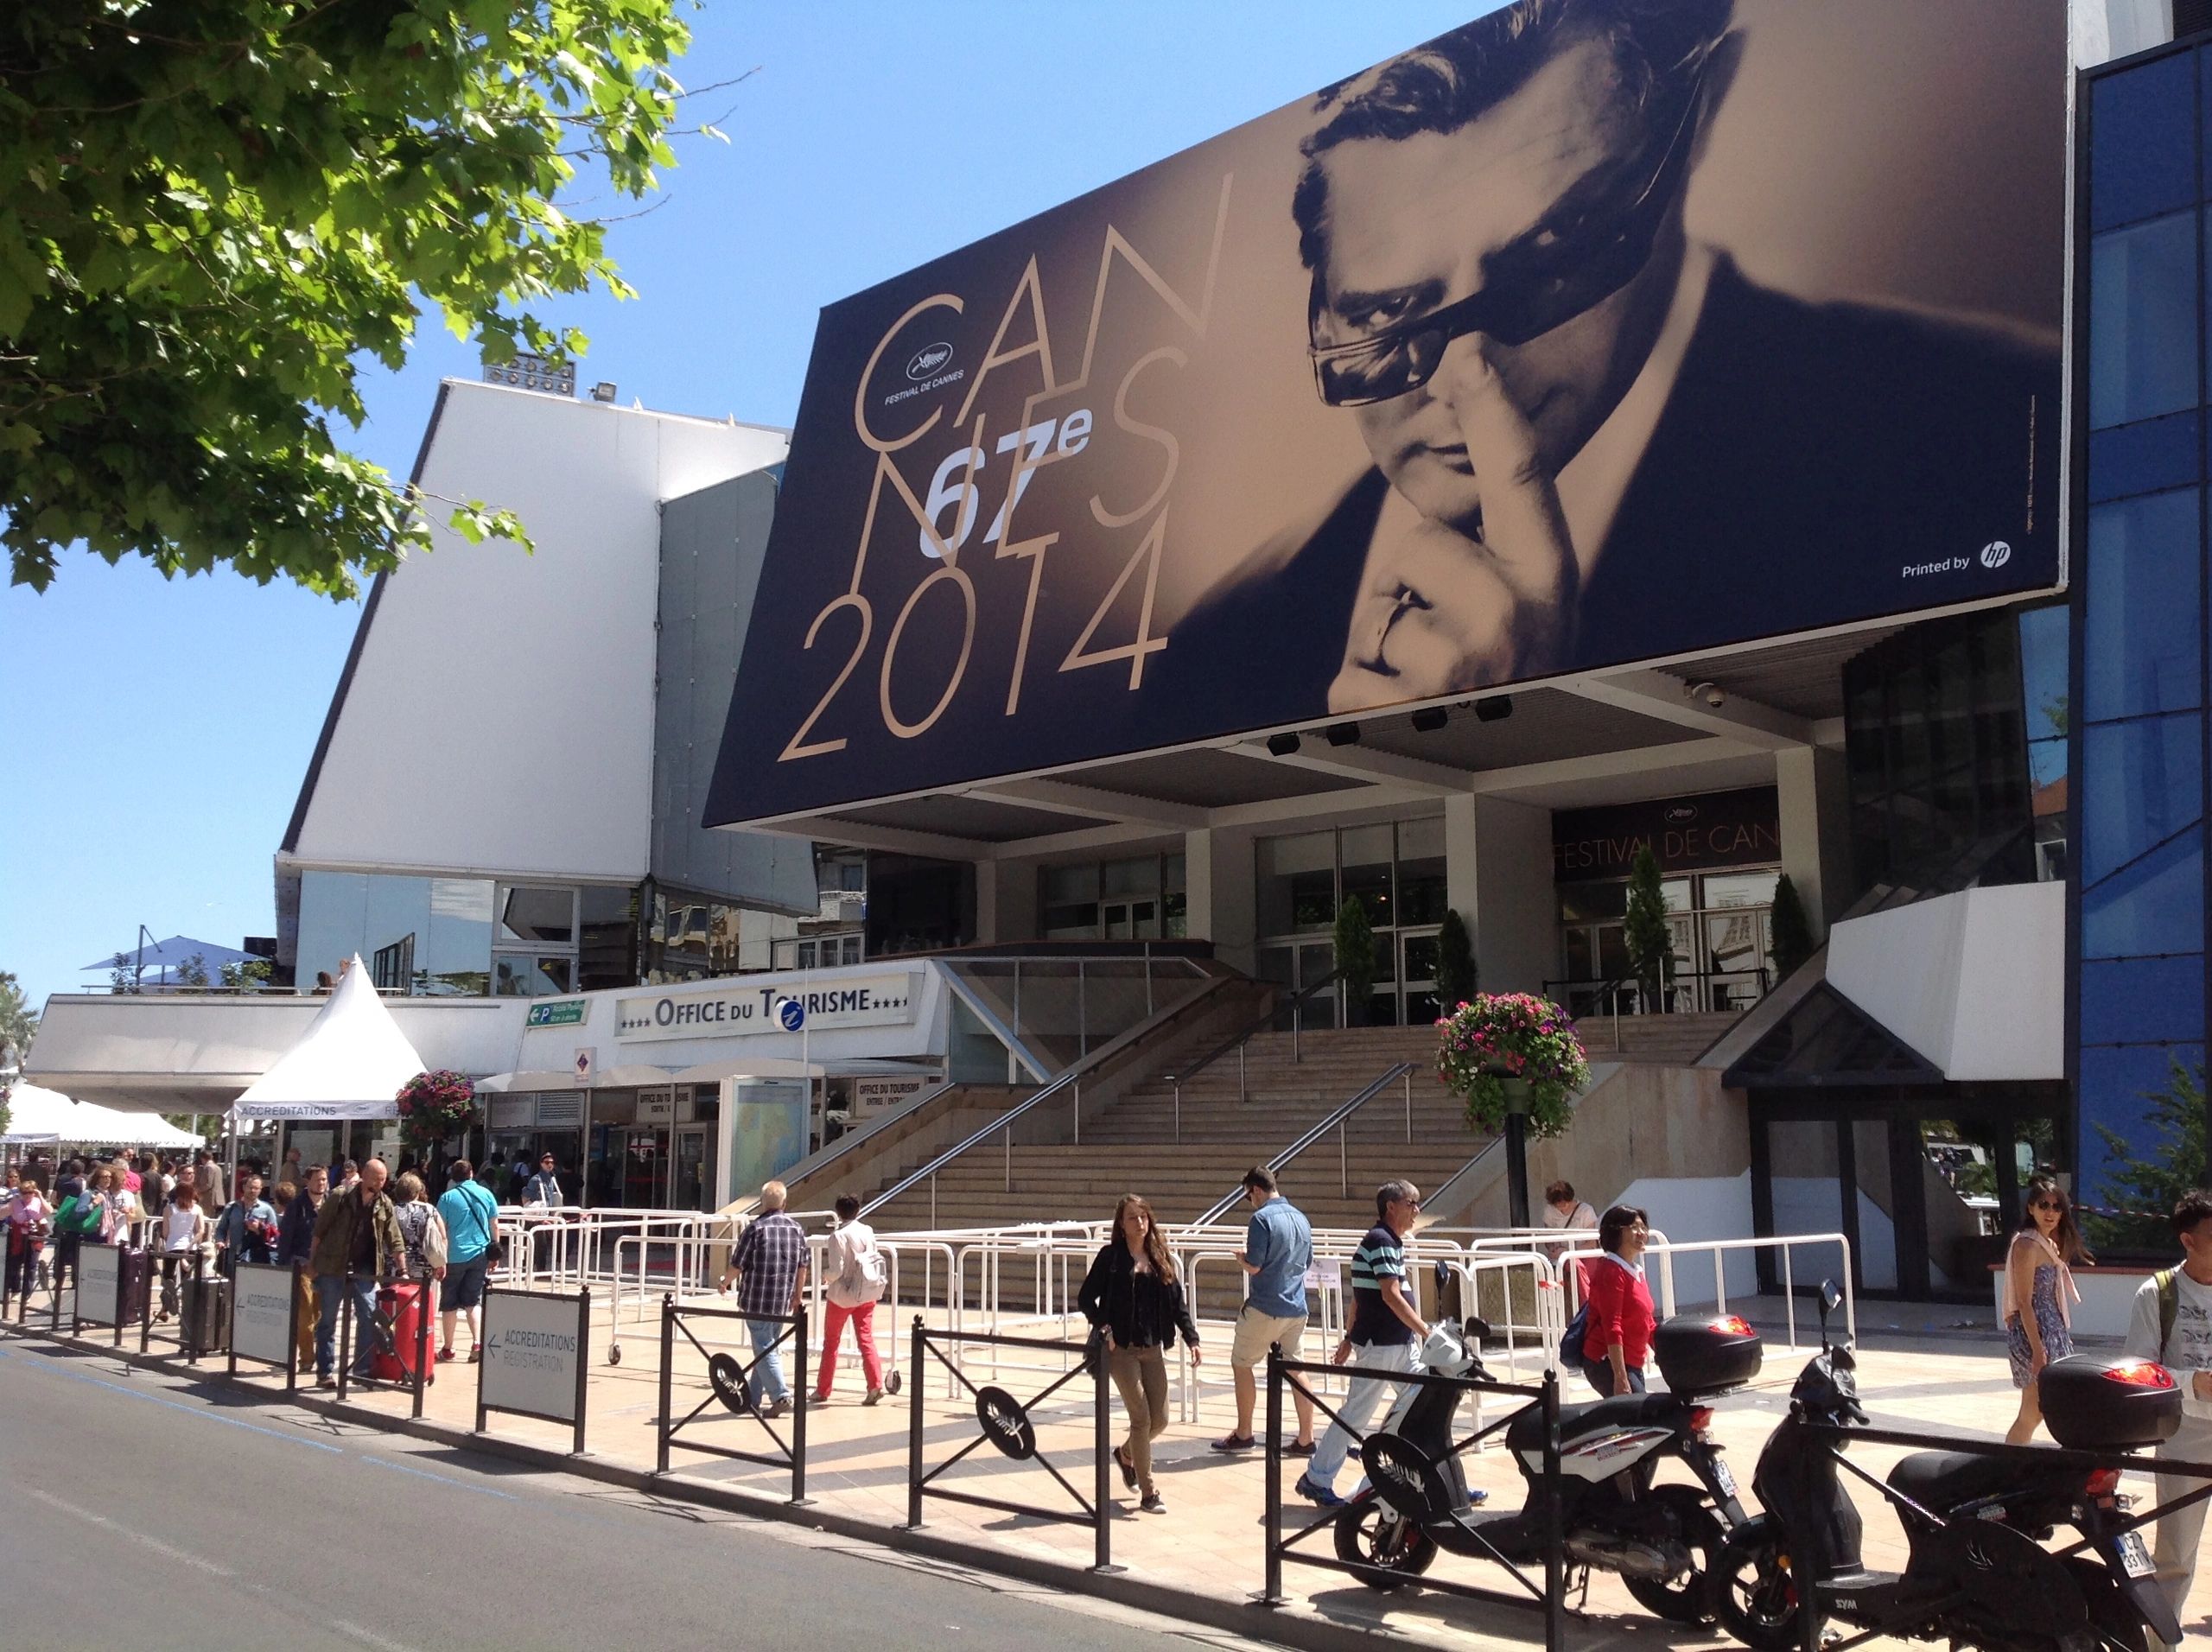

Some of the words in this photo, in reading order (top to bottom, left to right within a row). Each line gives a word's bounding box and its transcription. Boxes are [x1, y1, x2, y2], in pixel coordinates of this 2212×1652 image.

[884, 385, 918, 405] FESTIVAL
[920, 381, 931, 392] DE
[932, 370, 964, 388] CANNES
[1902, 559, 1950, 577] Printed
[1954, 556, 1970, 569] by
[1982, 541, 2010, 568] hp
[777, 500, 1170, 762] 2014
[1666, 829, 1700, 858] DE
[540, 1007, 550, 1021] P
[655, 998, 725, 1026] OFFICE
[731, 1005, 753, 1020] DU
[859, 1083, 879, 1095] OFFICE
[880, 1083, 888, 1094] DU
[241, 1106, 337, 1116] ACCREDITATIONS
[505, 1330, 575, 1352] ACCREDITATIONS
[504, 1350, 563, 1372] REGISTRATION
